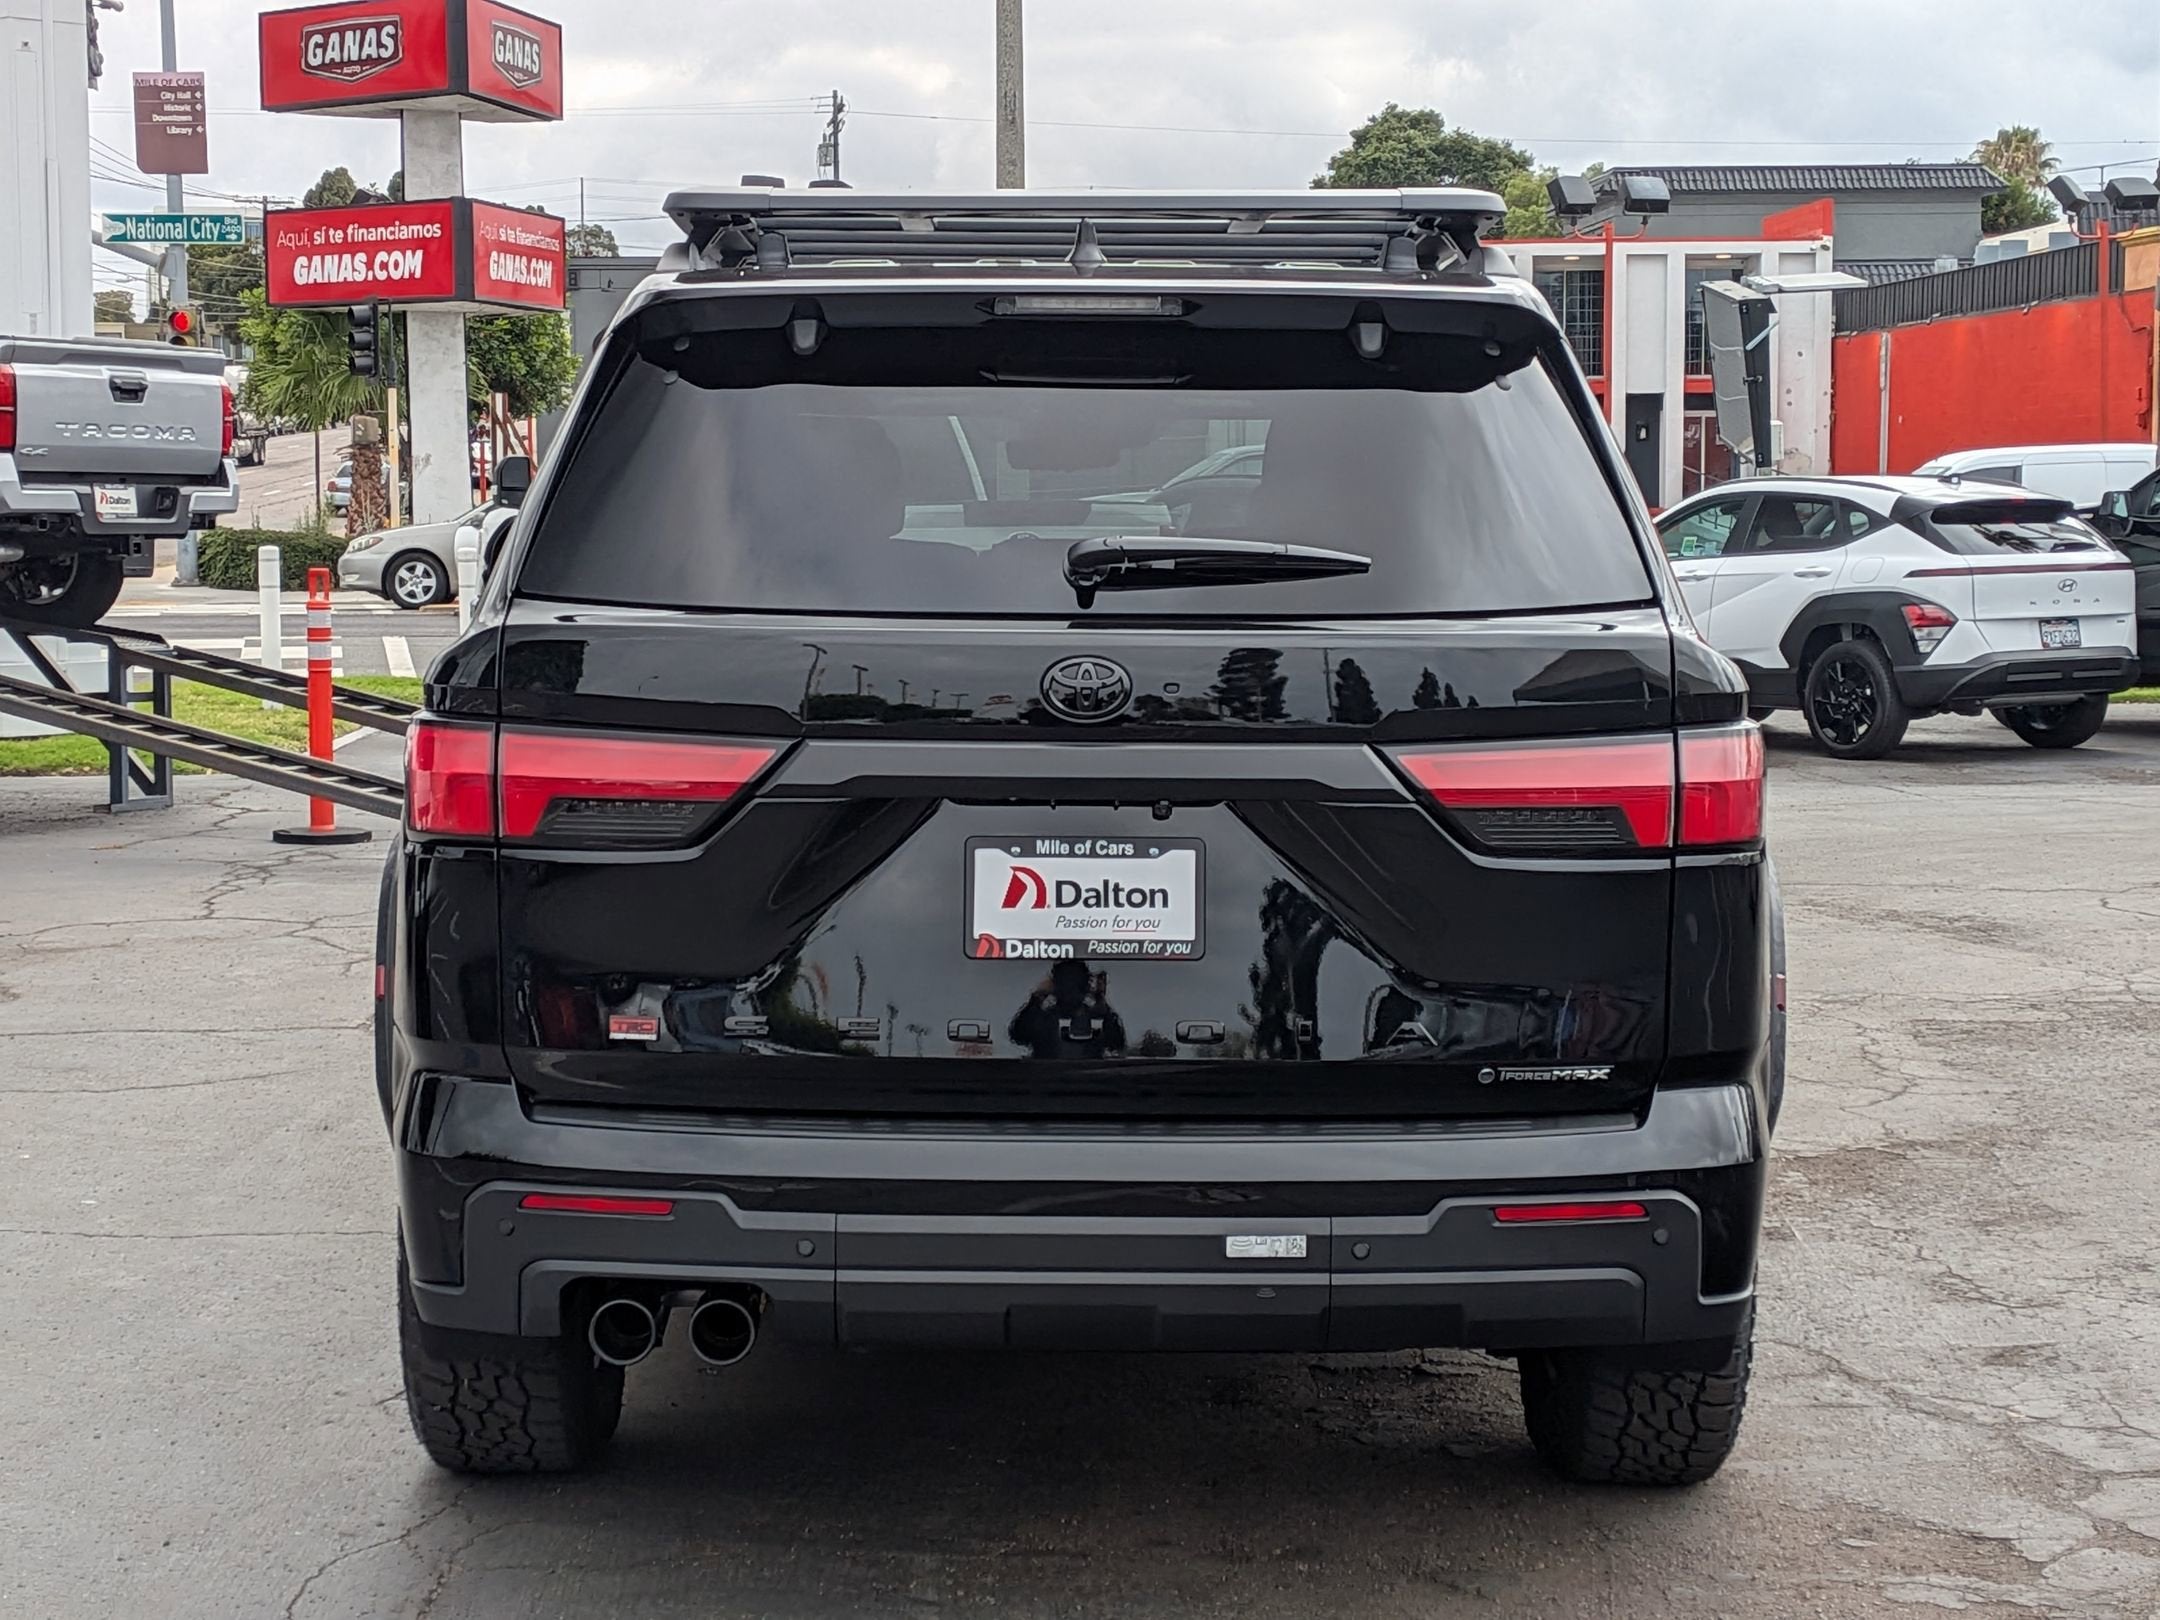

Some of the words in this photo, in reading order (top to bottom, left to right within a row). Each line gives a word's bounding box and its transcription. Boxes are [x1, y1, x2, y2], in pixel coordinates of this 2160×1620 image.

[307, 24, 396, 67] GANAS
[494, 30, 540, 74] GANAS
[160, 91, 175, 102] City
[166, 126, 193, 136] Library
[125, 217, 187, 240] National
[190, 217, 221, 242] City
[277, 229, 311, 249] Aquí,
[313, 225, 327, 244] sí
[328, 227, 343, 244] te
[346, 220, 442, 243] financiamos
[294, 250, 423, 285] GANAS.COM
[489, 250, 553, 289] GANAS.COM
[55, 422, 196, 441] TACOMA
[109, 495, 131, 505] Dalton
[1036, 839, 1069, 855] Mile
[1074, 839, 1091, 855] of
[1095, 840, 1135, 856] Cars
[1055, 879, 1169, 909] Dalton
[1055, 915, 1107, 929] Passion
[1112, 915, 1132, 929] for
[1134, 918, 1161, 931] you
[1006, 940, 1074, 959] Dalton
[1087, 940, 1140, 954] Passion
[1143, 940, 1163, 954] for
[1164, 942, 1191, 955] you
